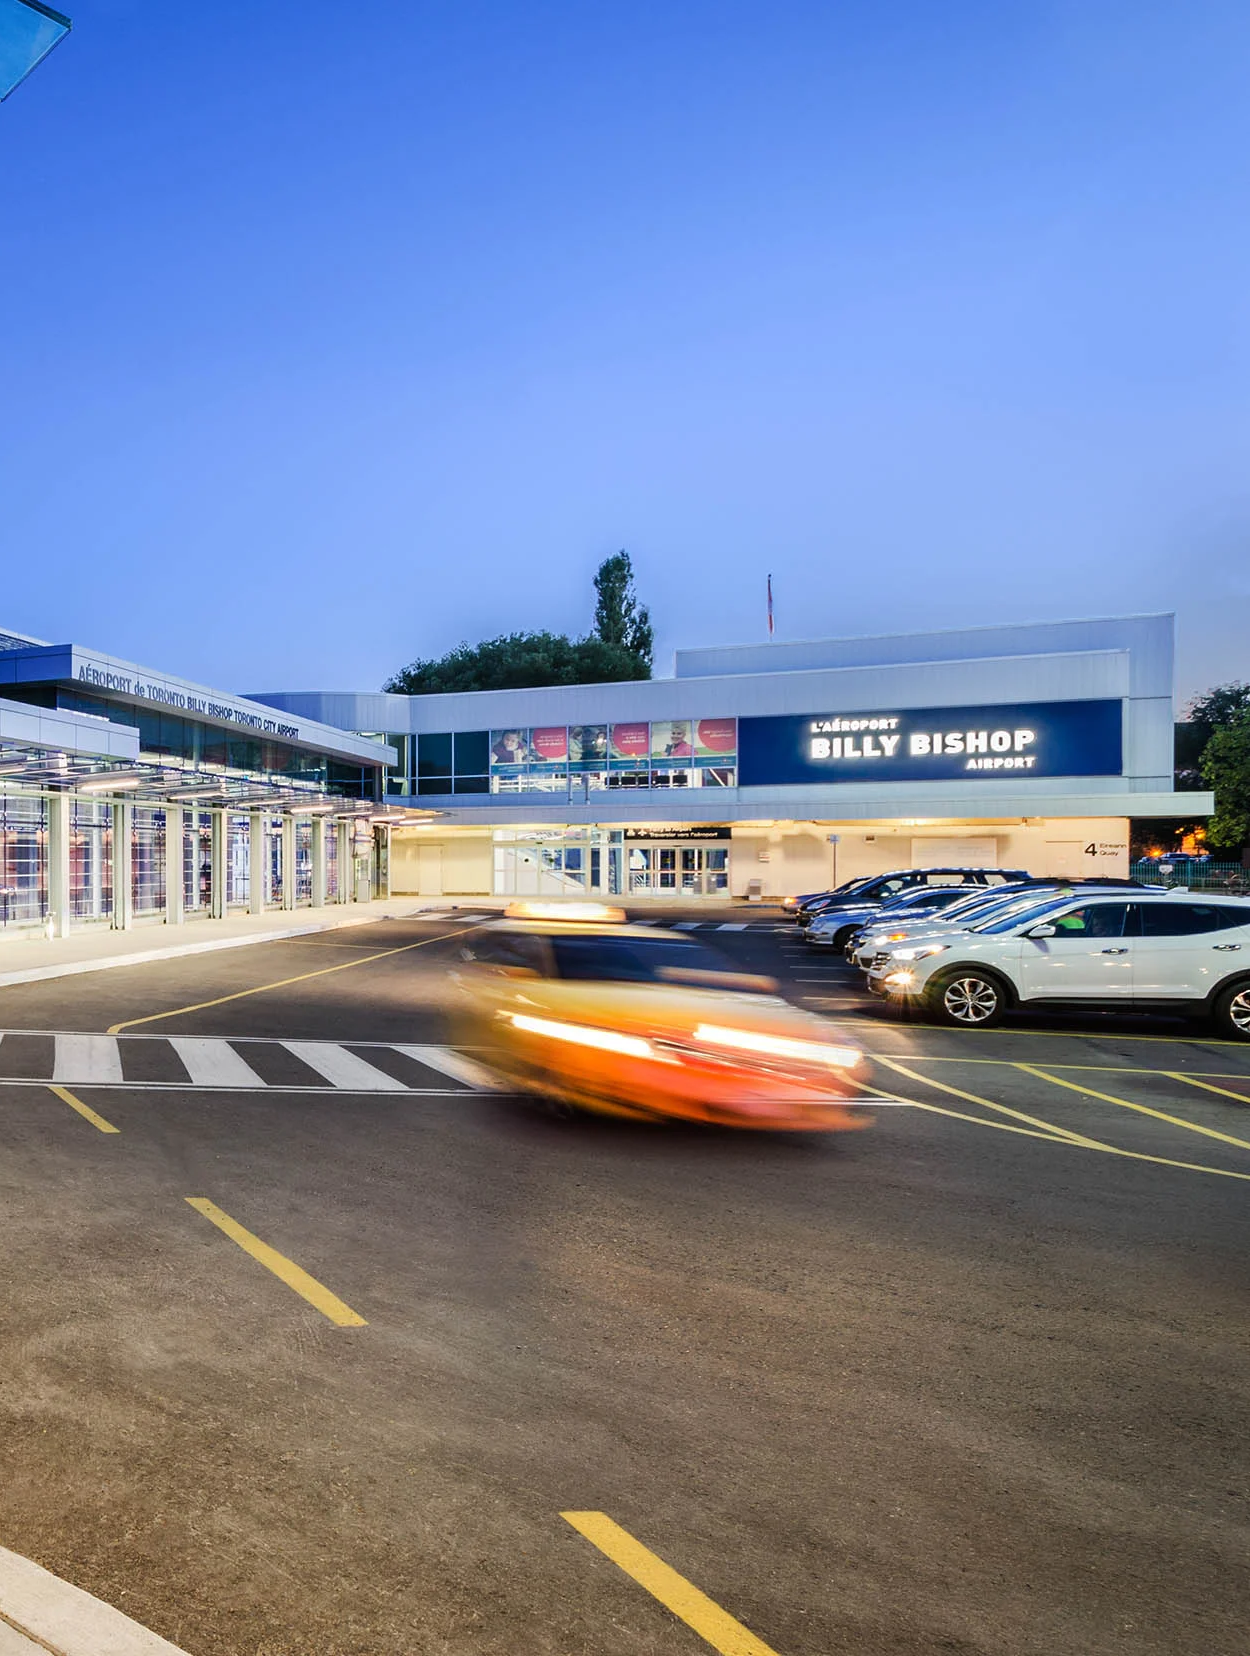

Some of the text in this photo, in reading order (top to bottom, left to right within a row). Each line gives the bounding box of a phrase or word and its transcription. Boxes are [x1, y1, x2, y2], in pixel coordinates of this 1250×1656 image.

[78, 664, 299, 740] AÉROPORT de TORONTO BILLY BISHOP TORONTO CITY AIRPORT
[811, 718, 899, 733] L'AÉROPORT
[811, 730, 1035, 759] BILLY BISHOP
[966, 757, 1035, 770] AIRPORT
[1084, 843, 1097, 857] 4
